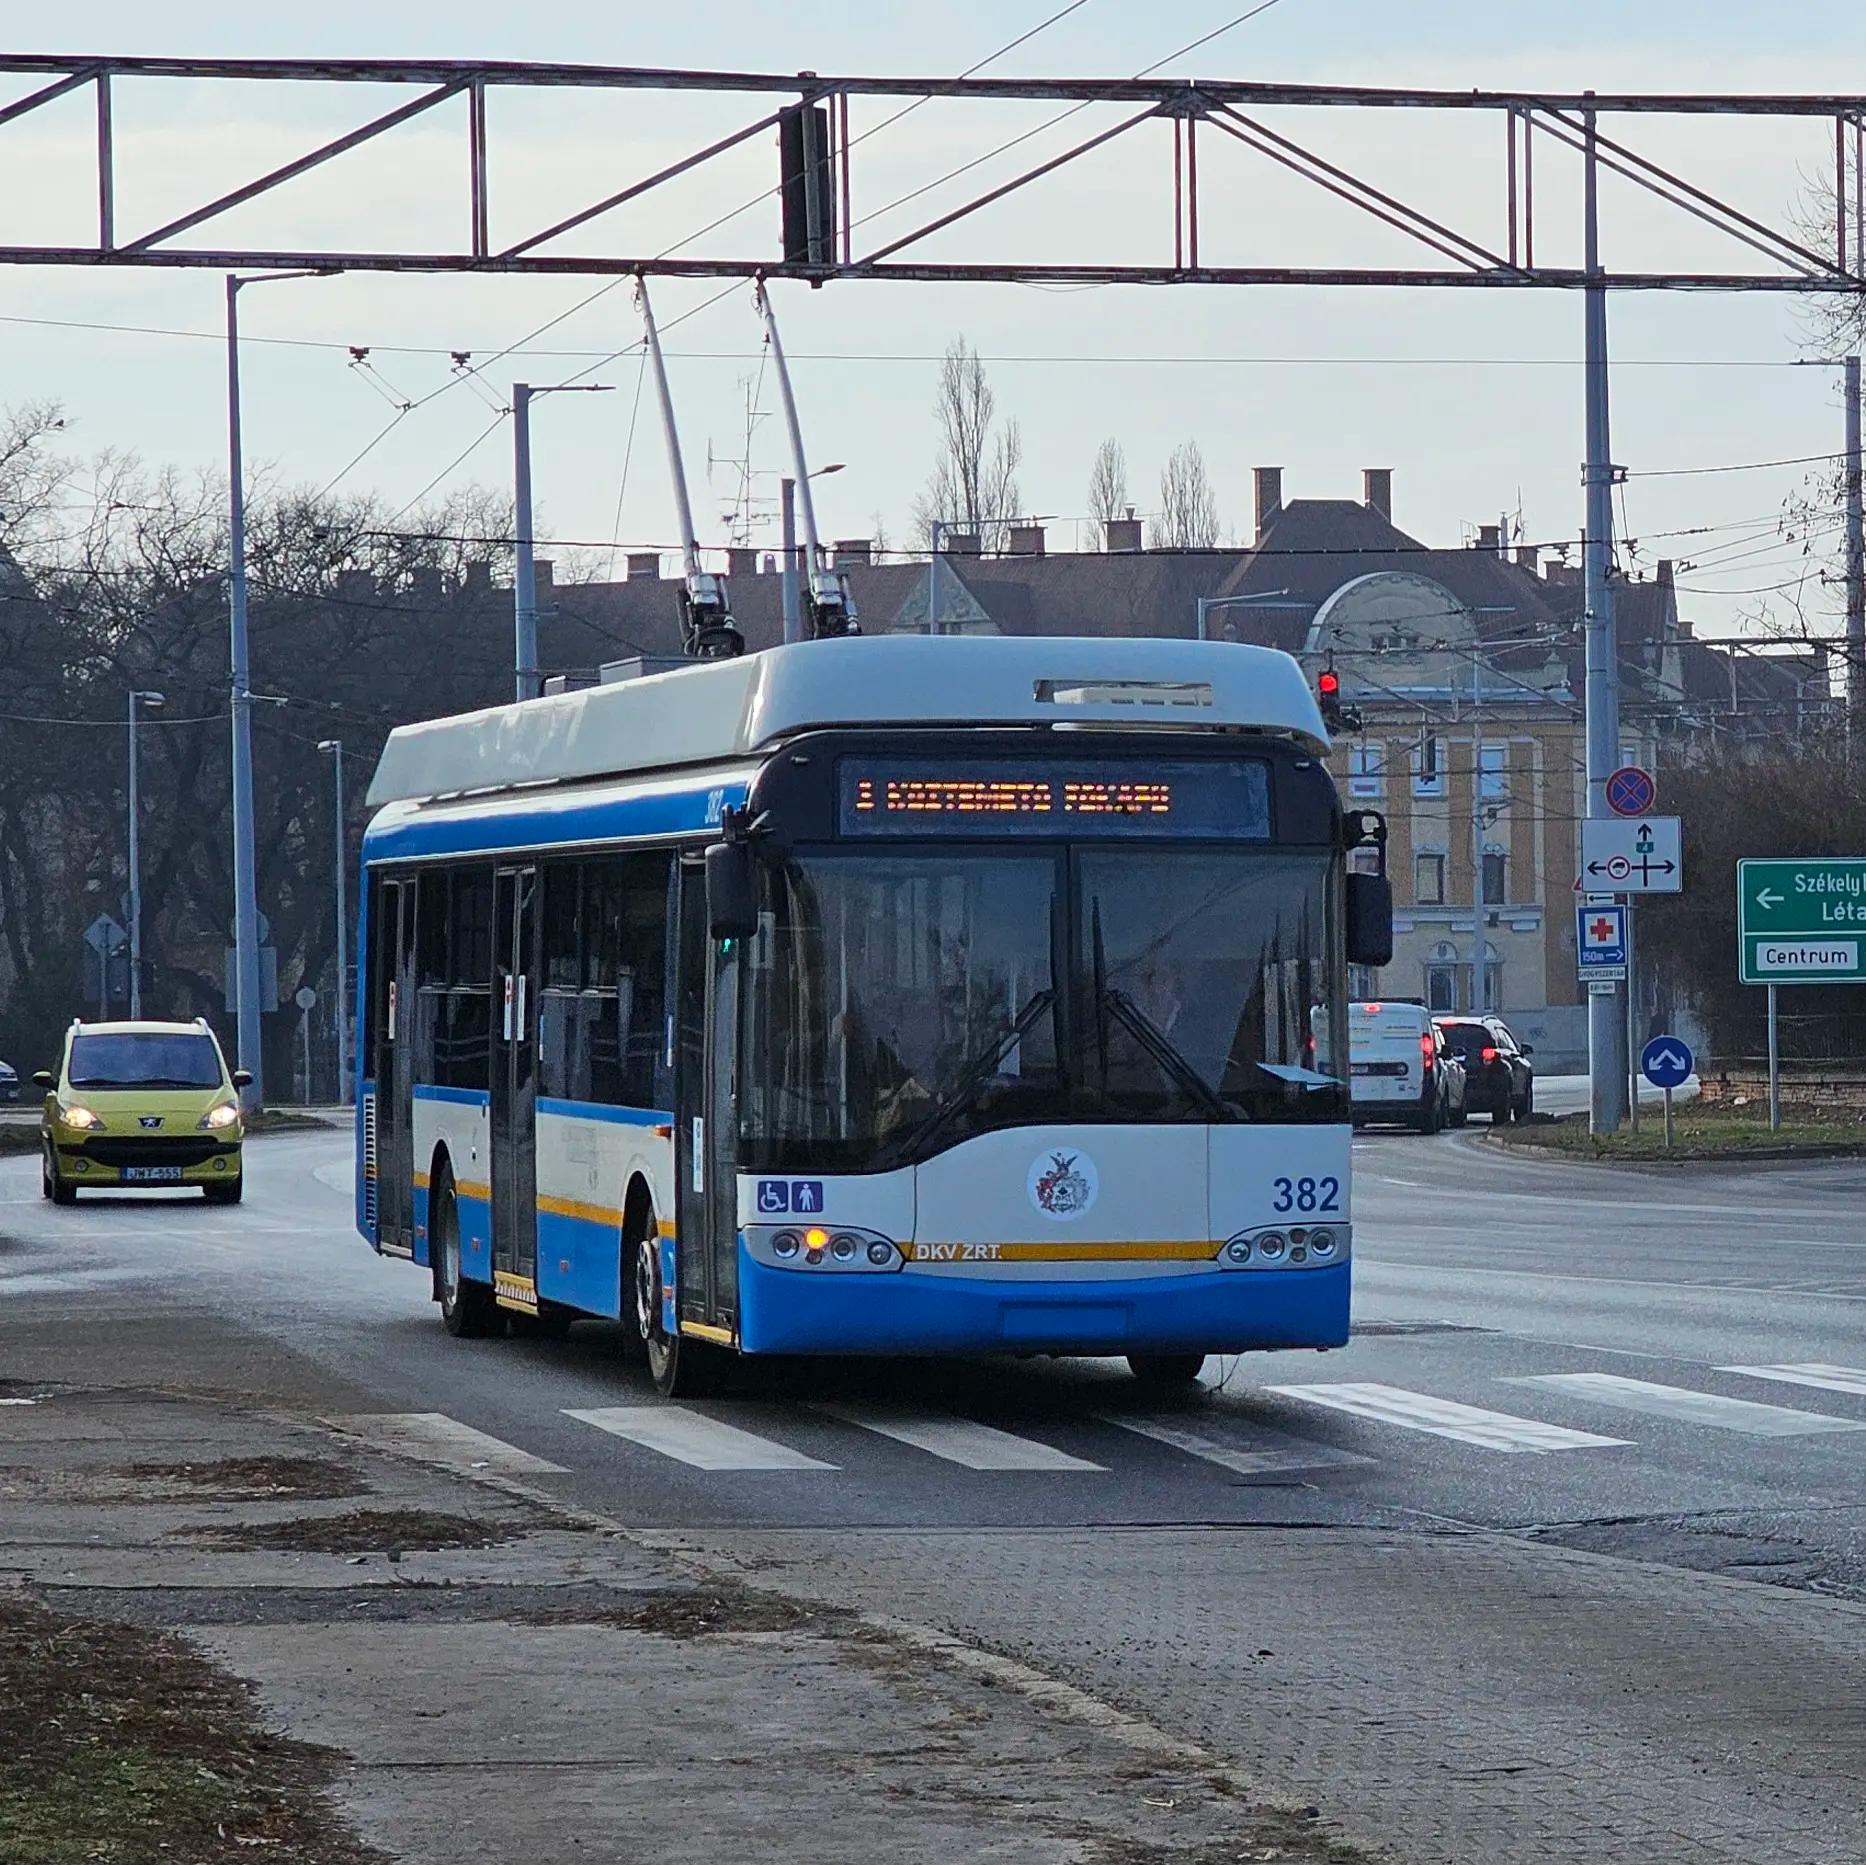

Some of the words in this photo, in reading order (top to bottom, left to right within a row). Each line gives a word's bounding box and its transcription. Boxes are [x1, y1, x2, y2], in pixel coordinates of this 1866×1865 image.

[1795, 872, 1866, 897] Székely
[1582, 951, 1605, 962] 150m
[1766, 948, 1848, 964] Centrum
[1273, 1176, 1339, 1212] 382
[916, 1243, 957, 1260] DKV
[961, 1243, 1003, 1260] ZRT.
